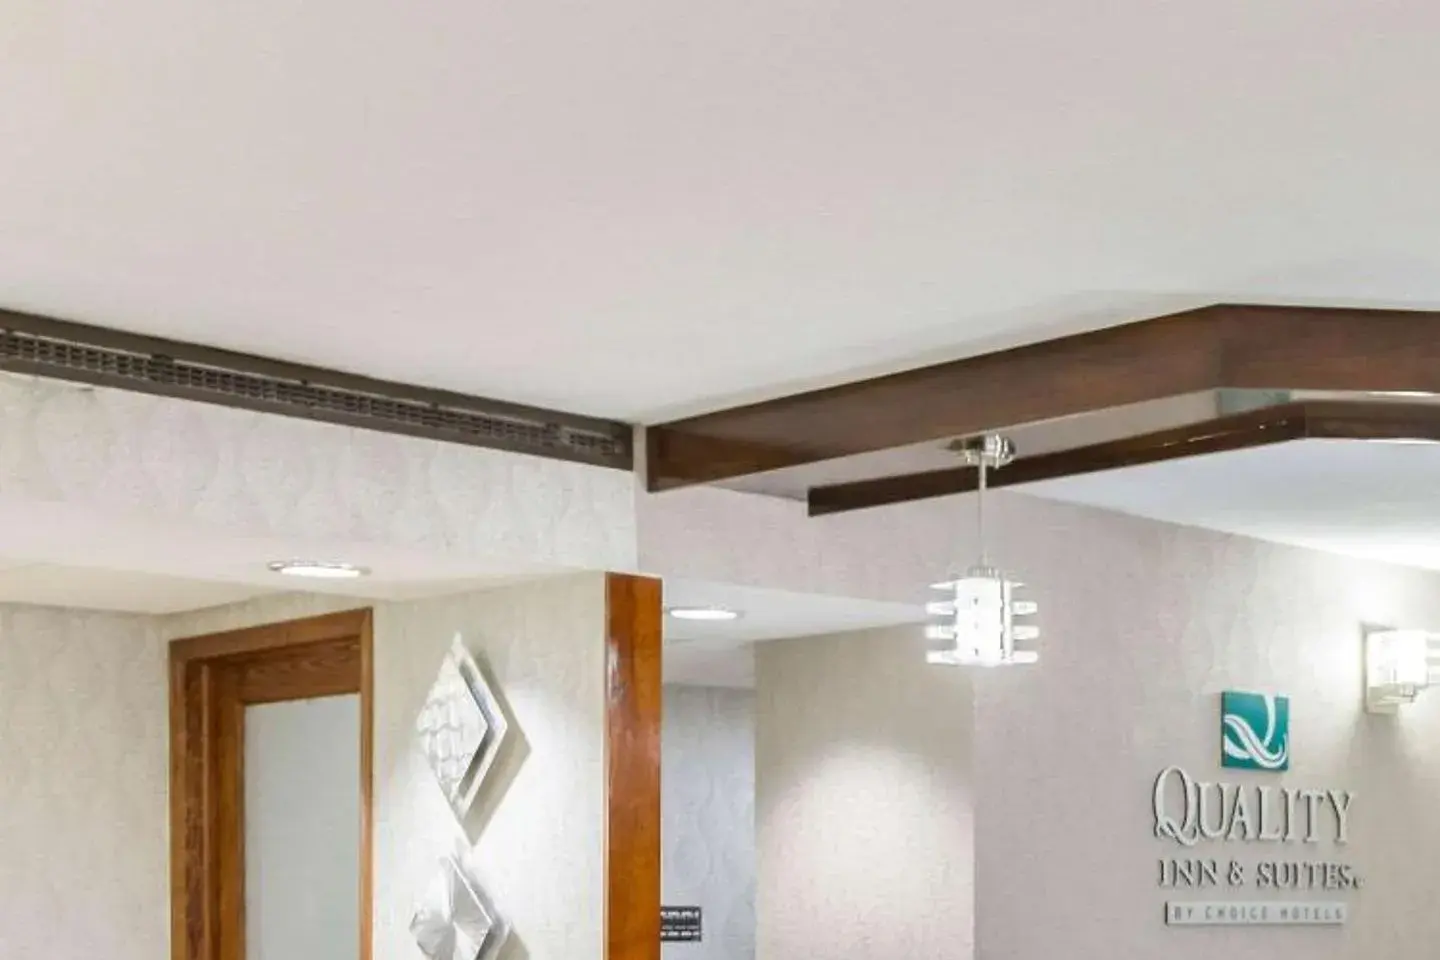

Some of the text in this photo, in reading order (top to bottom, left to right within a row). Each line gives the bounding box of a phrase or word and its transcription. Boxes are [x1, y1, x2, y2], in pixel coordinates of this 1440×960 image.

[1152, 764, 1353, 846] QUALITY
[1158, 858, 1219, 888] INN
[1227, 859, 1245, 888] &
[1174, 906, 1344, 921] BY CHOICE HOTELS
